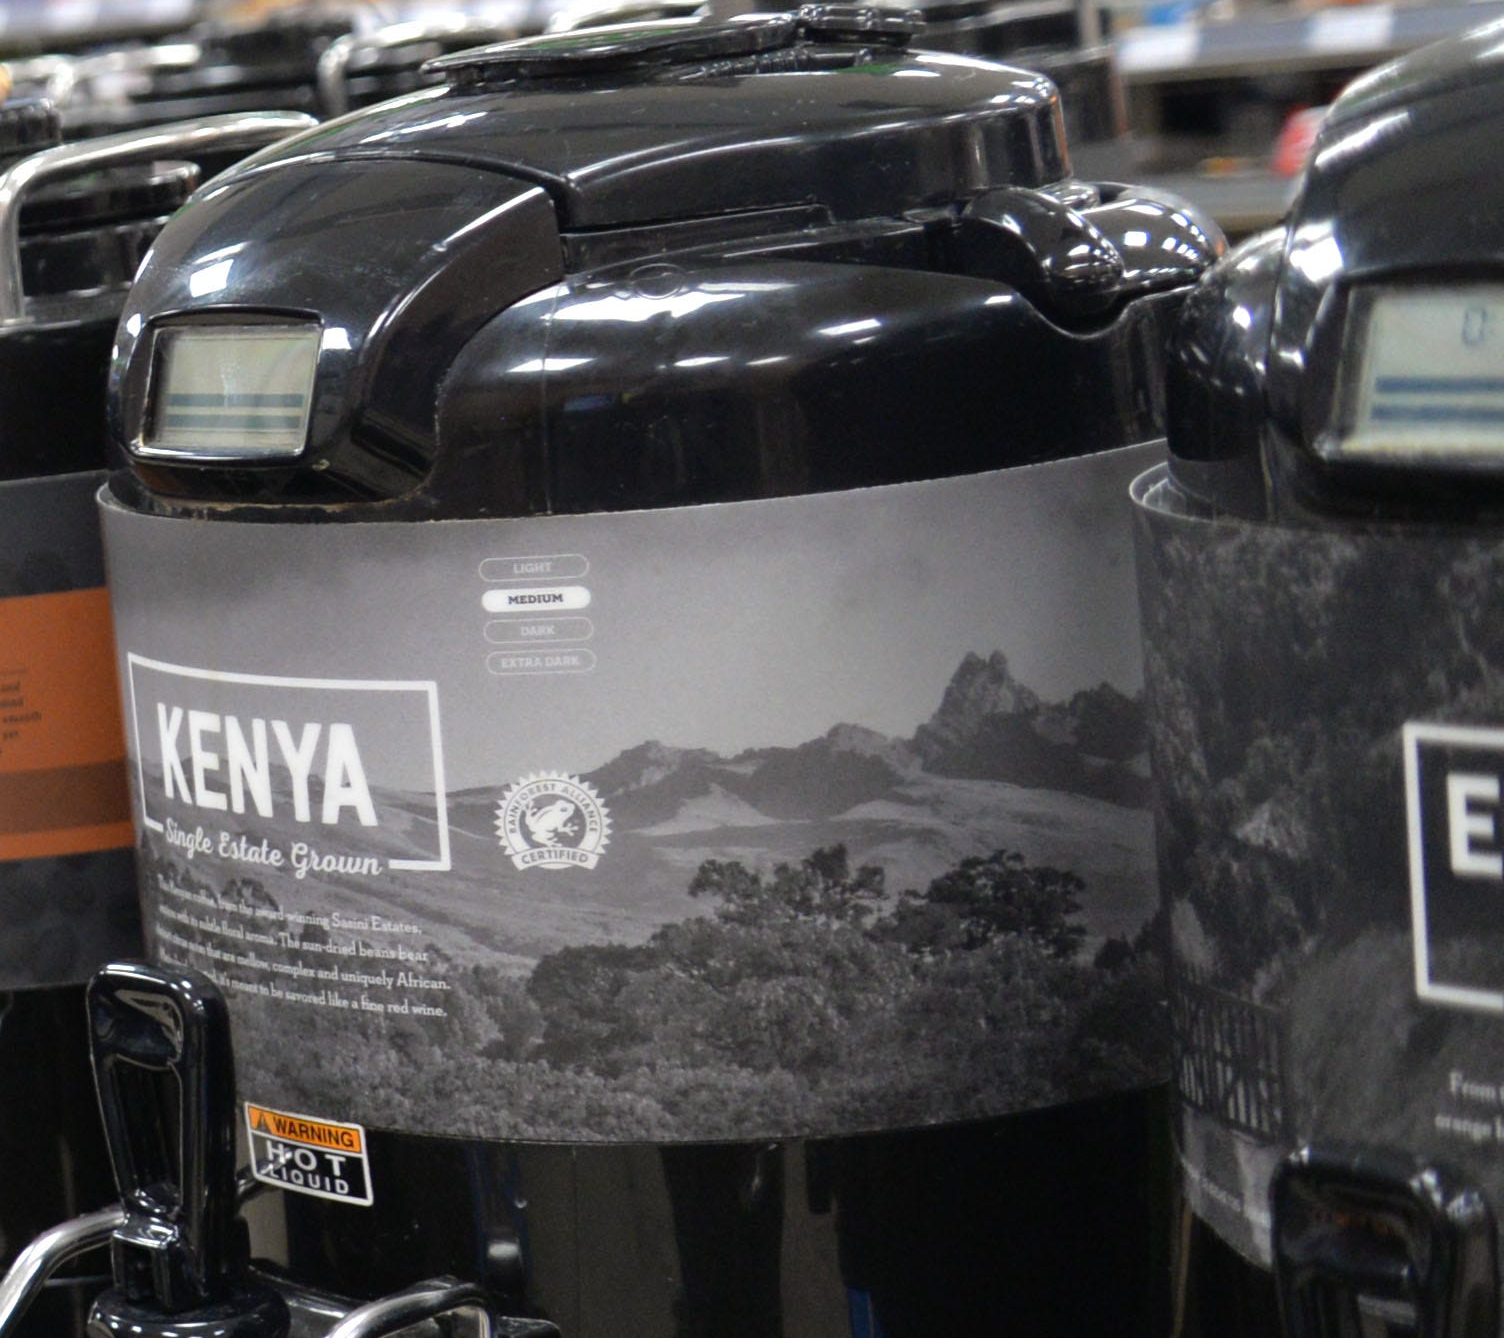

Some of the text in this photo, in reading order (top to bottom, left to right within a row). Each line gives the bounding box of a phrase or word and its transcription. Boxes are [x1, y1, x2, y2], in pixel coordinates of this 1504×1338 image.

[512, 561, 553, 574] LIGHT
[508, 593, 564, 605] MEDIUM
[520, 625, 556, 637] DARK
[501, 655, 580, 669] EXTRA DARK
[156, 702, 379, 827] KENYA
[509, 782, 598, 835] RAINFOREST ALLIANCE
[164, 817, 383, 879] Single Estate Grown
[520, 849, 589, 864] CERTIFIED
[332, 912, 368, 931] Sasini
[371, 915, 423, 935] Estates,
[278, 932, 300, 950] The
[302, 938, 356, 956] sun-dried
[359, 941, 396, 959] beans
[398, 944, 429, 961] bear
[272, 961, 316, 981] complex
[317, 965, 338, 981] and
[341, 969, 394, 991] uniquely
[396, 972, 452, 990] African.
[270, 982, 284, 1000] be
[285, 990, 326, 1006] savored
[328, 991, 349, 1009] like
[351, 999, 359, 1010] a
[360, 992, 385, 1013] fine
[388, 998, 409, 1015] red
[412, 1003, 449, 1018] wine.
[272, 1115, 354, 1148] WARNING
[266, 1139, 347, 1177] HOT
[269, 1165, 350, 1195] LIQUID
